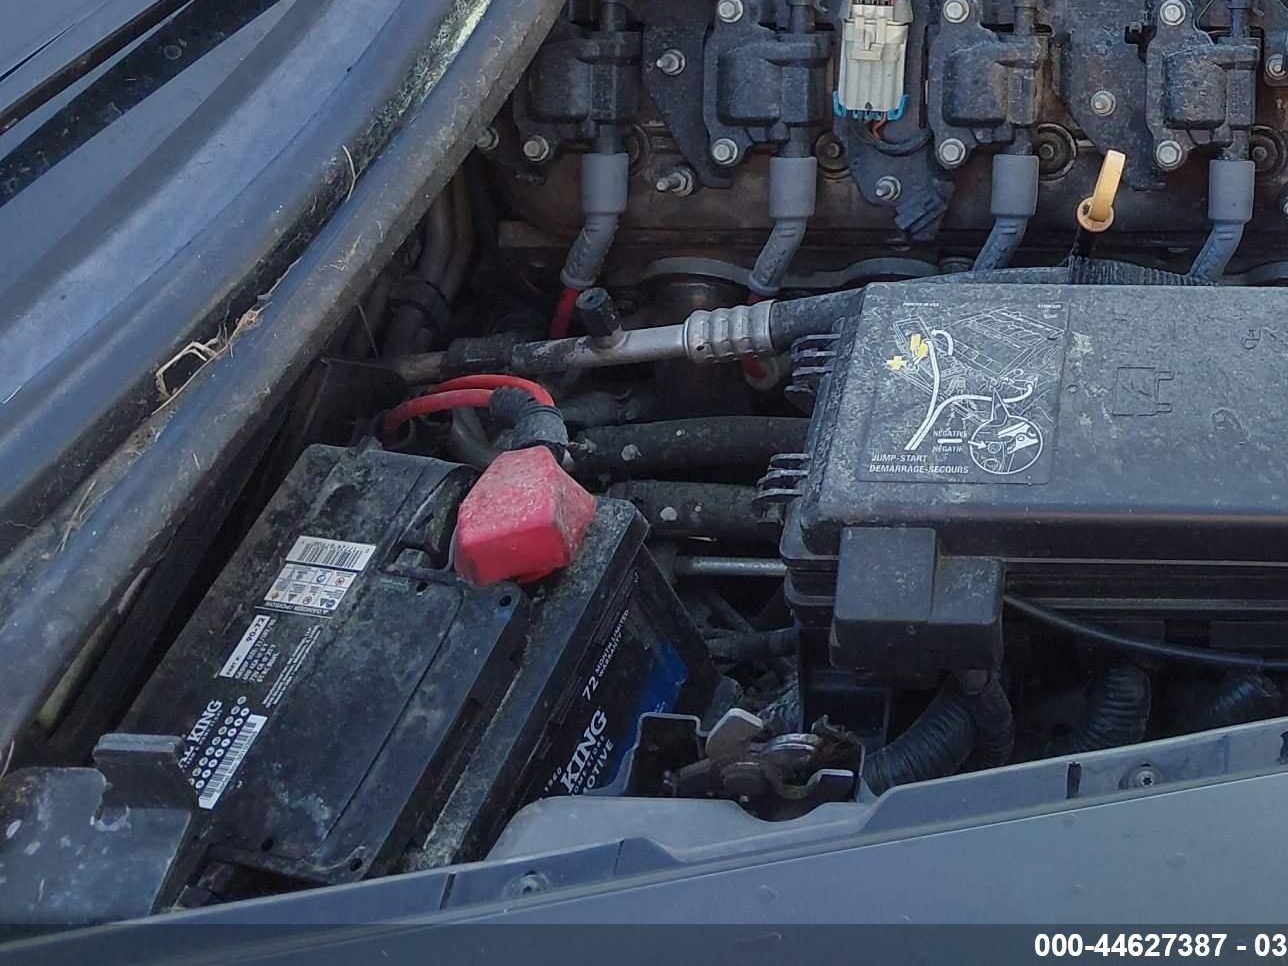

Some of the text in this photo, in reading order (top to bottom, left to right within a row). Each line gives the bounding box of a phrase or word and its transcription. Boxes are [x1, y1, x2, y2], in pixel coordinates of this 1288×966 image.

[932, 430, 968, 439] NEGATIVE
[871, 454, 928, 463] JUMP-START
[244, 617, 265, 642] 90-72
[580, 608, 629, 700] 72 MONTH LIMITED
[597, 631, 623, 677] WARRANTY
[186, 698, 222, 743] KING
[559, 707, 608, 793] KING
[587, 734, 605, 766] STORE
[543, 765, 562, 792] 1960
